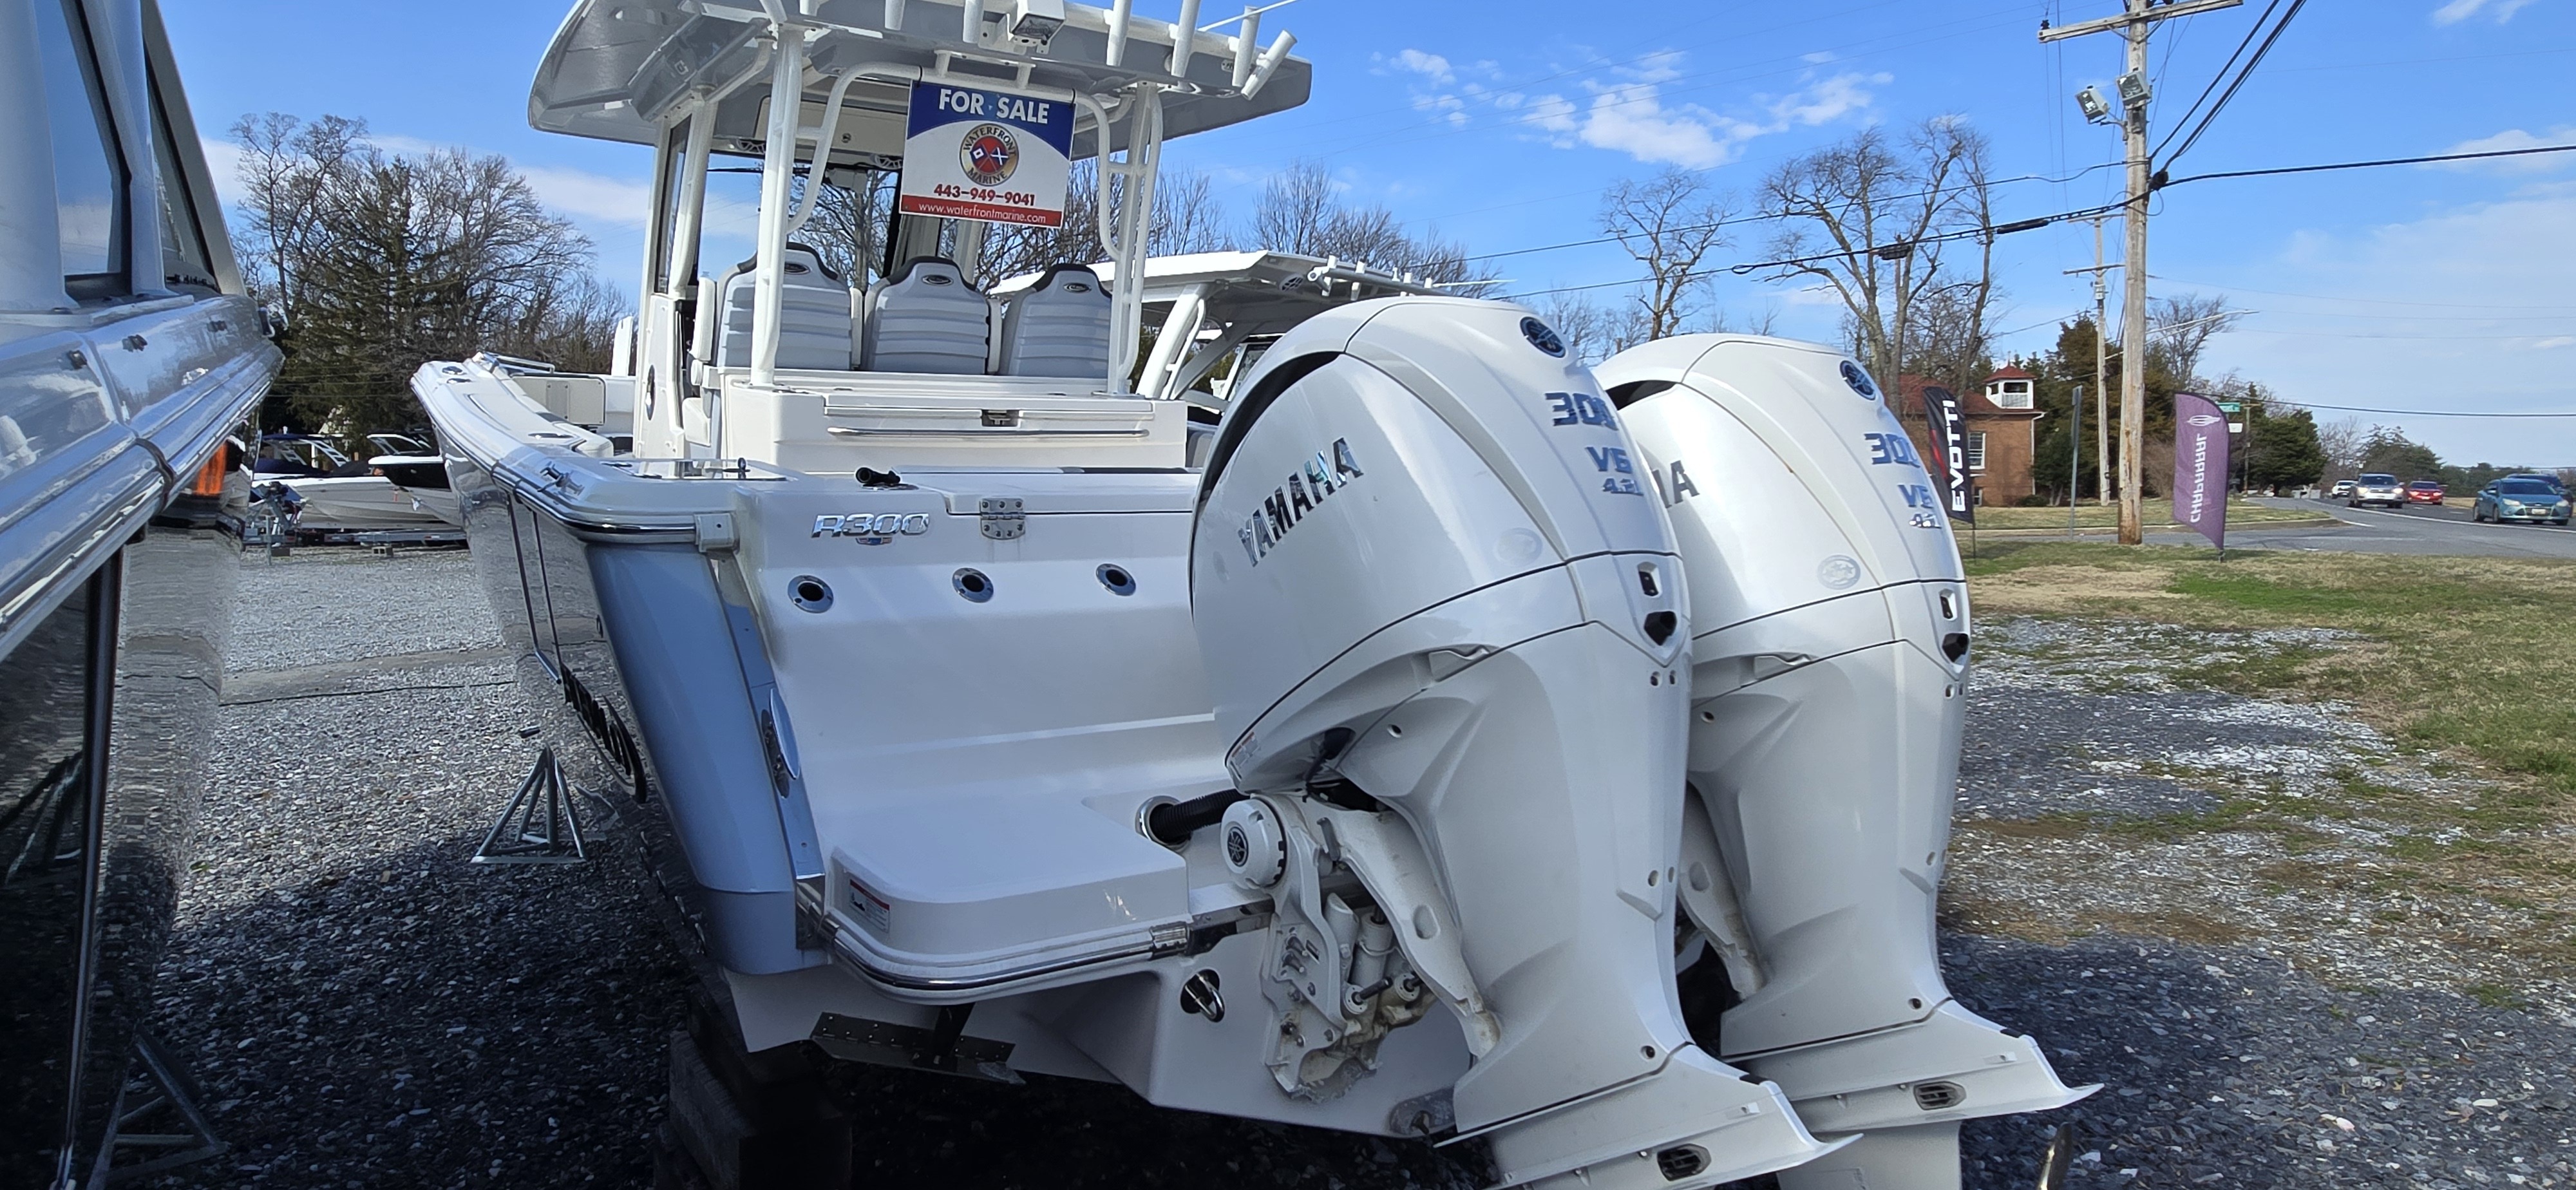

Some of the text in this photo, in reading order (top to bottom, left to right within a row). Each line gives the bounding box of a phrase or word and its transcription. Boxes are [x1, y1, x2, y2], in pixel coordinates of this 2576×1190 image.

[938, 88, 1050, 124] FOR SALE
[963, 126, 1017, 156] WATERFRONT
[967, 167, 1008, 185] MARINE
[934, 184, 1036, 207] 443-949-9041
[918, 203, 1046, 224] www.waterfrontmarine.com
[1585, 446, 1633, 474] V6
[1942, 400, 1965, 511] EVOTTI
[1237, 437, 1364, 567] YAMAHA
[1897, 484, 1934, 509] V6
[811, 513, 930, 538] R300
